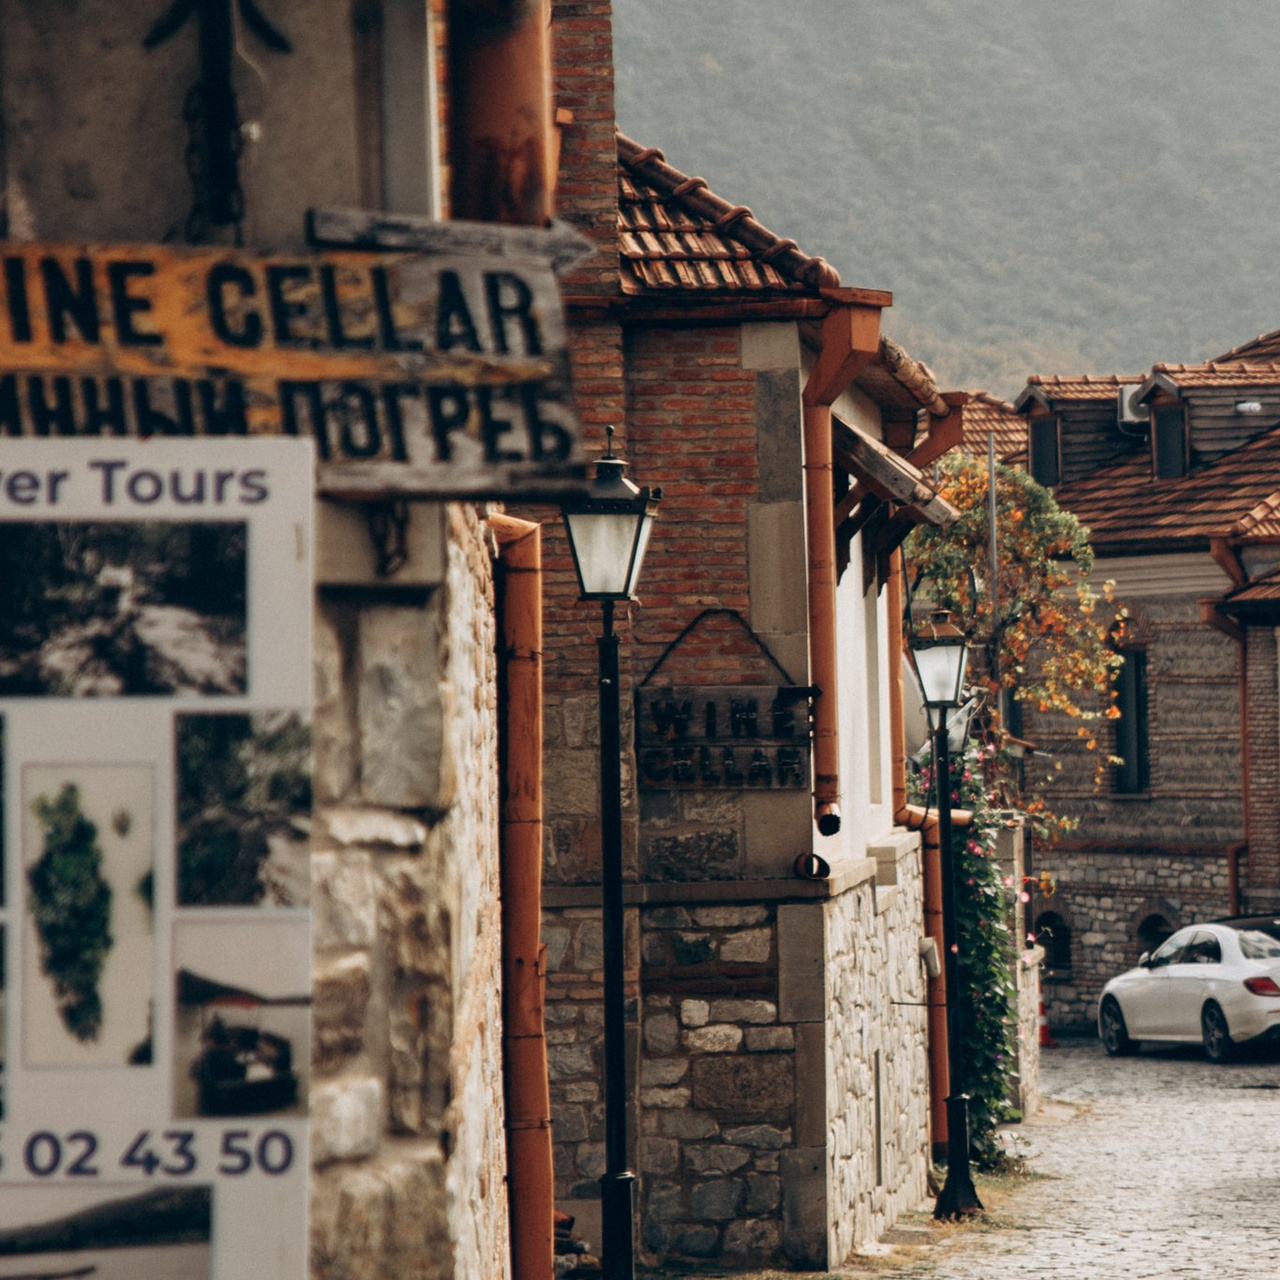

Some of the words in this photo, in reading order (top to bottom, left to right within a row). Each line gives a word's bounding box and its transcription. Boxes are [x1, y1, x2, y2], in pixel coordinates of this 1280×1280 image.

[4, 256, 165, 345] INE
[206, 263, 544, 356] CELLAR
[278, 378, 573, 462] ПОГРЕБ
[0, 469, 69, 506] er
[87, 461, 270, 506] Tours
[651, 699, 796, 738] WINE
[645, 746, 803, 786] CELLAR
[24, 1130, 98, 1176] 02
[120, 1131, 197, 1176] 43
[217, 1130, 294, 1176] 50
